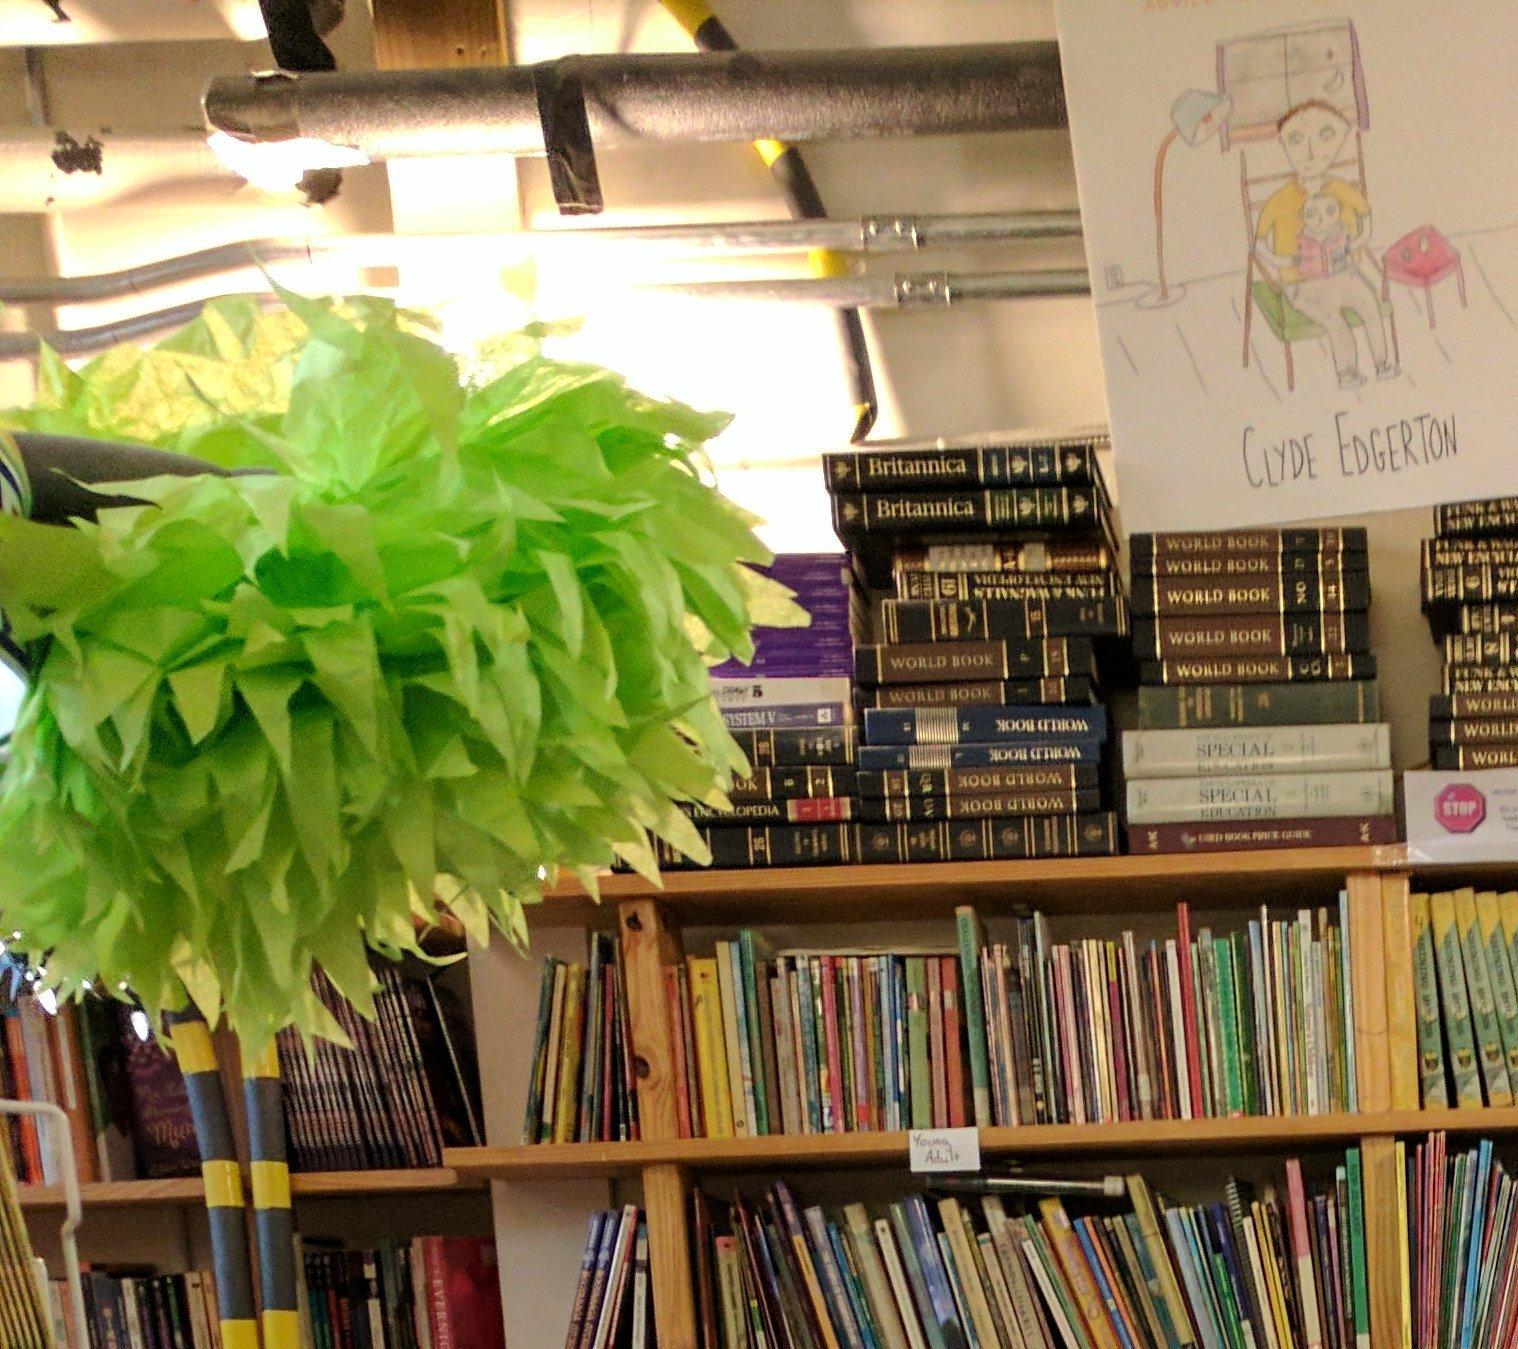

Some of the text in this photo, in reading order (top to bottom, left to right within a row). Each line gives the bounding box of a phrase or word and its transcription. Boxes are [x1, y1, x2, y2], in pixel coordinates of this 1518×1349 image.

[1334, 411, 1462, 478] EDGERTON
[868, 456, 967, 478] Britannica
[876, 497, 975, 519] Britannica
[1167, 535, 1270, 550] WORLD BOOK
[1166, 558, 1270, 574] WORLD BOOK
[1167, 587, 1272, 605] WORLD BOOK
[1168, 628, 1273, 645] WORLD BOOK
[890, 653, 994, 670] WORLD BOOK
[1176, 661, 1279, 679] WORLD BOOK
[890, 687, 992, 703] WORLD BOOK
[994, 718, 1089, 734] WORLD BOOK
[989, 746, 1083, 762] WORLD BOOK
[1196, 741, 1275, 758] SPECIAL
[958, 771, 1064, 788] WORLD BOOK
[1199, 788, 1277, 804] SPECIAL
[959, 796, 1064, 814] WORLD BOOK
[1441, 800, 1477, 818] STOP
